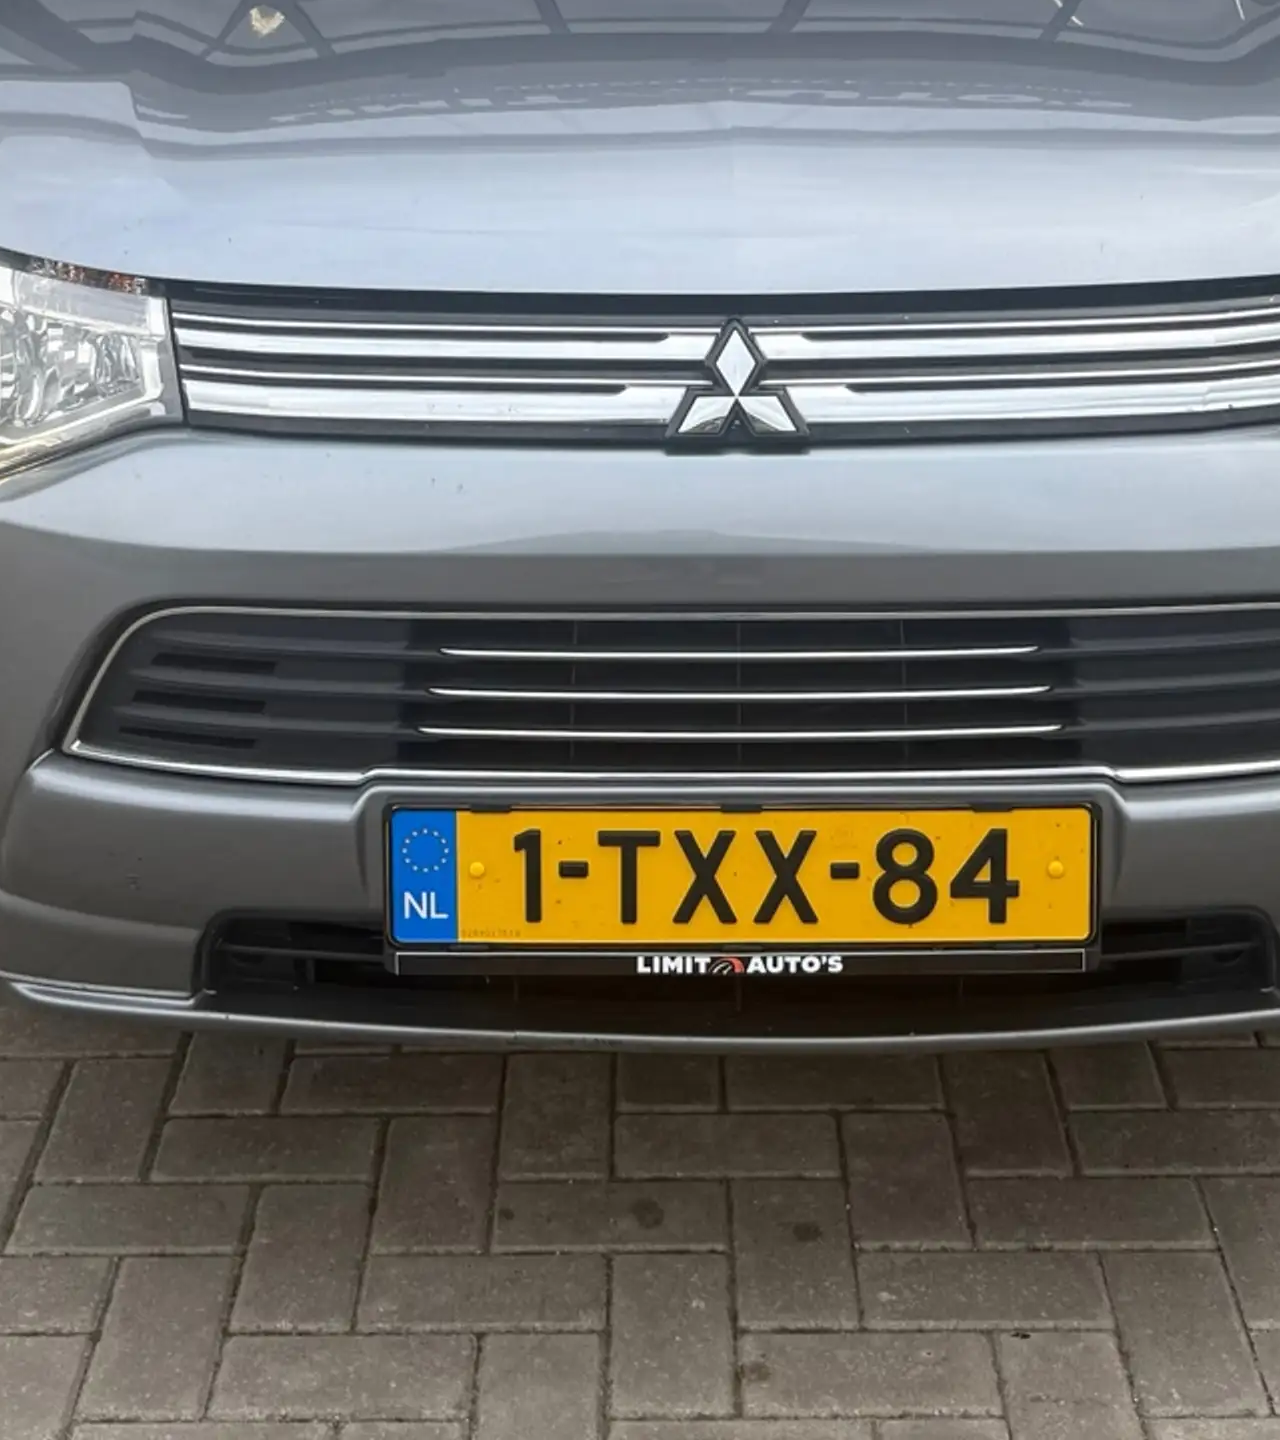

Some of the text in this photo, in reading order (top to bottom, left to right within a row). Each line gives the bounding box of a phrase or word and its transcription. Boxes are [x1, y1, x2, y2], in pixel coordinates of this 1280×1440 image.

[513, 827, 1020, 925] 1-TXX-84
[402, 891, 449, 921] NL
[636, 955, 844, 973] LIMIT AUTO'S
